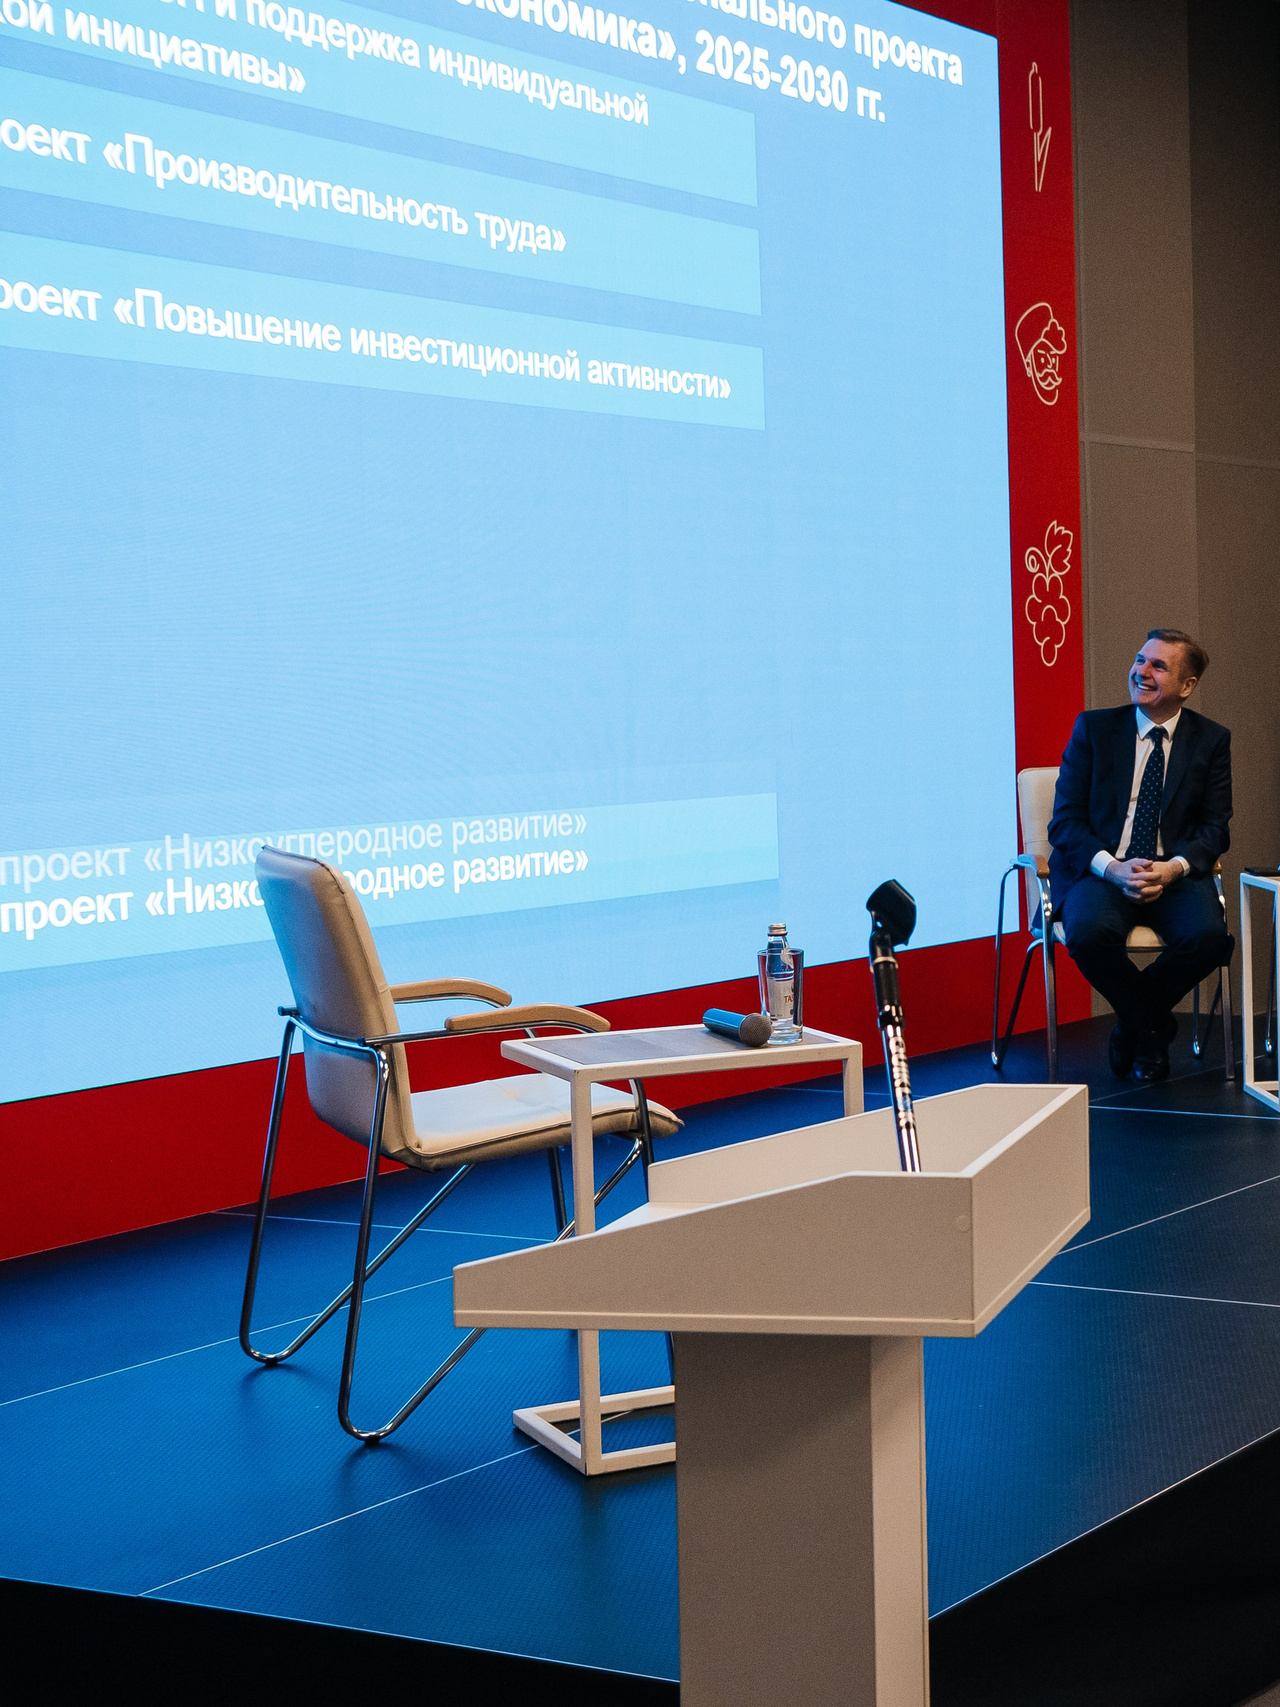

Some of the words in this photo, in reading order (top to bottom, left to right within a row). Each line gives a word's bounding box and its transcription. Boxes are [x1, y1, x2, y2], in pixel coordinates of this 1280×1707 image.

[0, 0, 55, 37] ой
[65, 8, 306, 93] инициативы»
[246, 0, 421, 68] поддержка
[428, 44, 650, 126] индивидуальной
[455, 0, 687, 75] ономика»,
[695, 29, 849, 112] 2025-2030
[856, 85, 886, 123] гг.
[684, 0, 847, 50] ального
[854, 24, 963, 85] проекта
[0, 118, 92, 164] оект
[103, 132, 469, 235] «Производительность
[474, 211, 567, 255] труда»
[113, 287, 342, 352] «Повышение
[350, 327, 580, 382] инвестиционной
[587, 360, 731, 399] активности»
[0, 847, 131, 894] проект
[452, 813, 587, 854] развитие»
[0, 891, 134, 941] проект
[453, 849, 589, 894] развитие»
